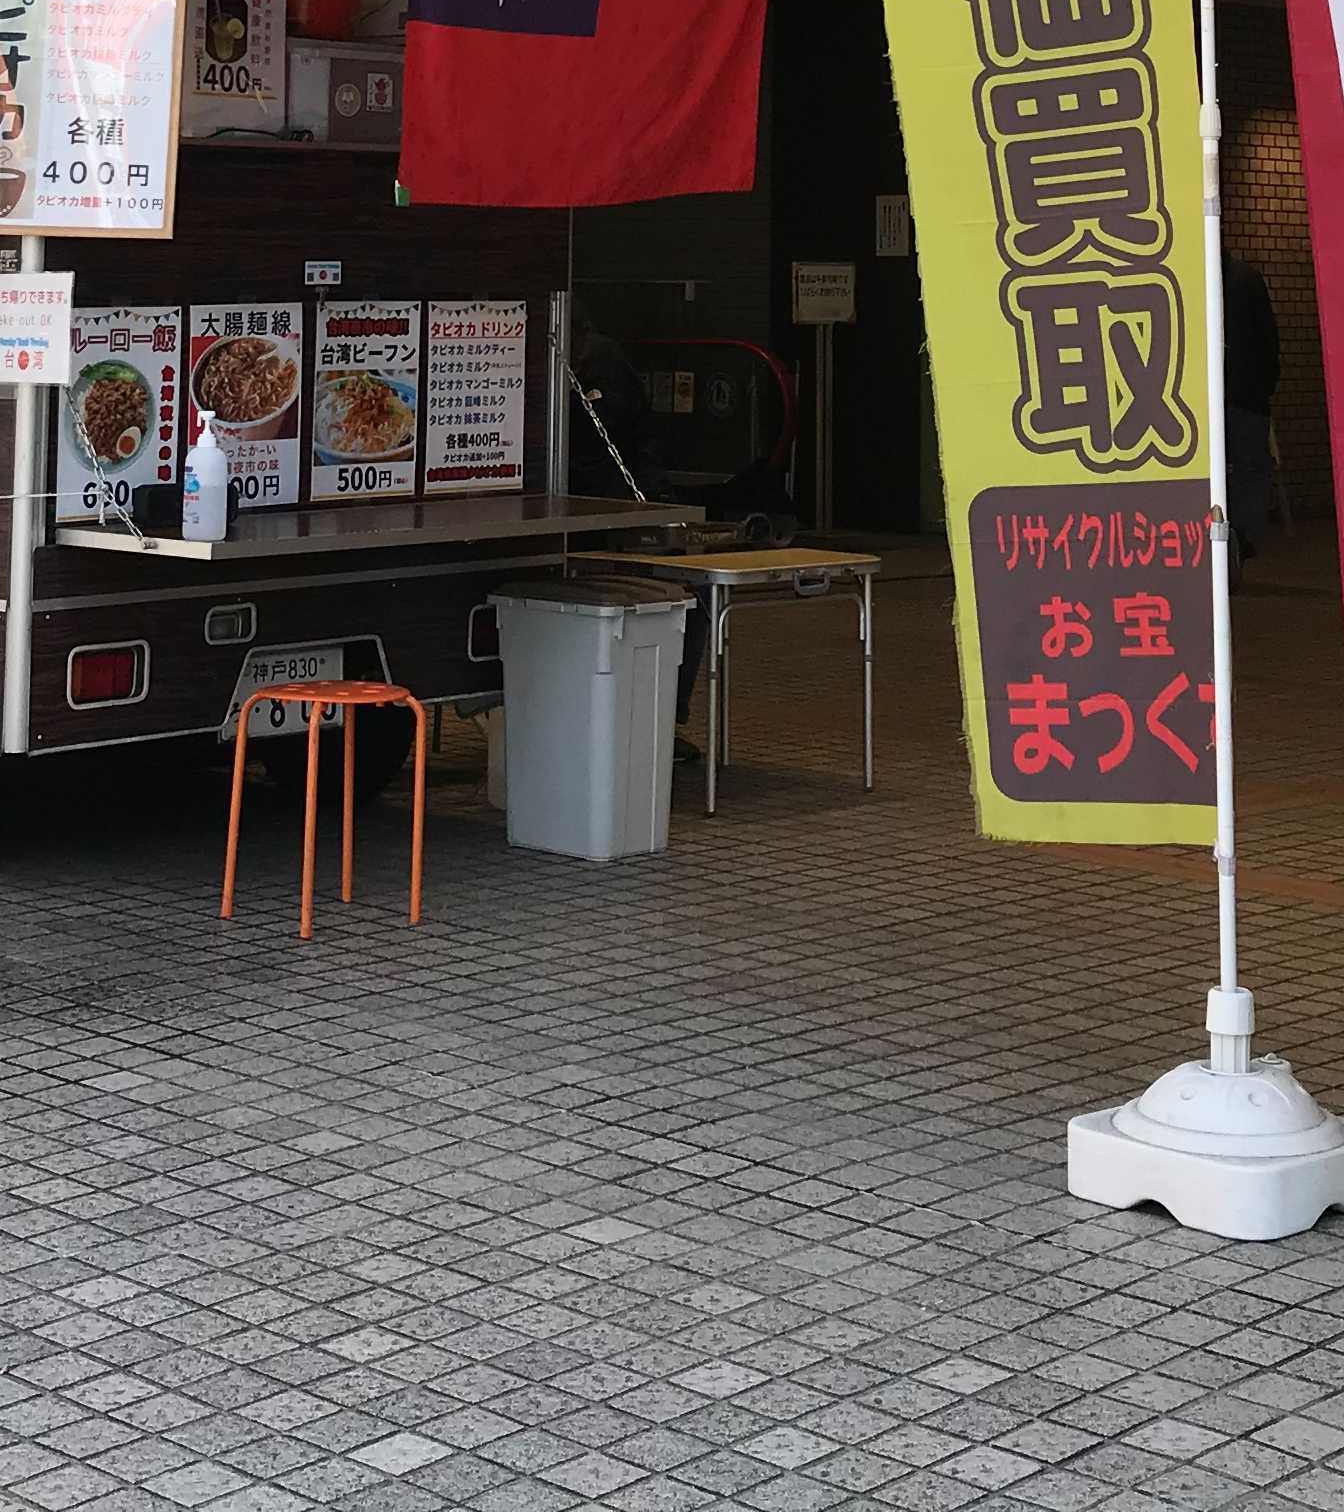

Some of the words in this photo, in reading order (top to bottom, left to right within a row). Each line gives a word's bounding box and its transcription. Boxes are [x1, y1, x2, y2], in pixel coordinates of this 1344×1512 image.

[203, 63, 263, 94] 400円
[67, 117, 125, 147] 各種
[42, 161, 150, 187] 400円
[431, 321, 476, 337] タピオカ
[481, 321, 524, 336] ドリンク
[320, 342, 417, 365] 台湾ビーフン
[430, 344, 464, 356] タピオカ
[467, 344, 515, 355] ミルクティー
[430, 362, 464, 374] タピオカ
[466, 361, 491, 373] ミルク
[429, 380, 463, 391] タピオカ
[465, 377, 523, 390] マンゴーミルク
[429, 397, 463, 409] タピオカ
[429, 415, 463, 426] タピオカ
[445, 432, 500, 449] 各種400円
[336, 464, 392, 493] 500円
[997, 512, 1213, 570] リサイクルショッ
[1040, 592, 1175, 658] お宝
[253, 657, 318, 683] 神戸830
